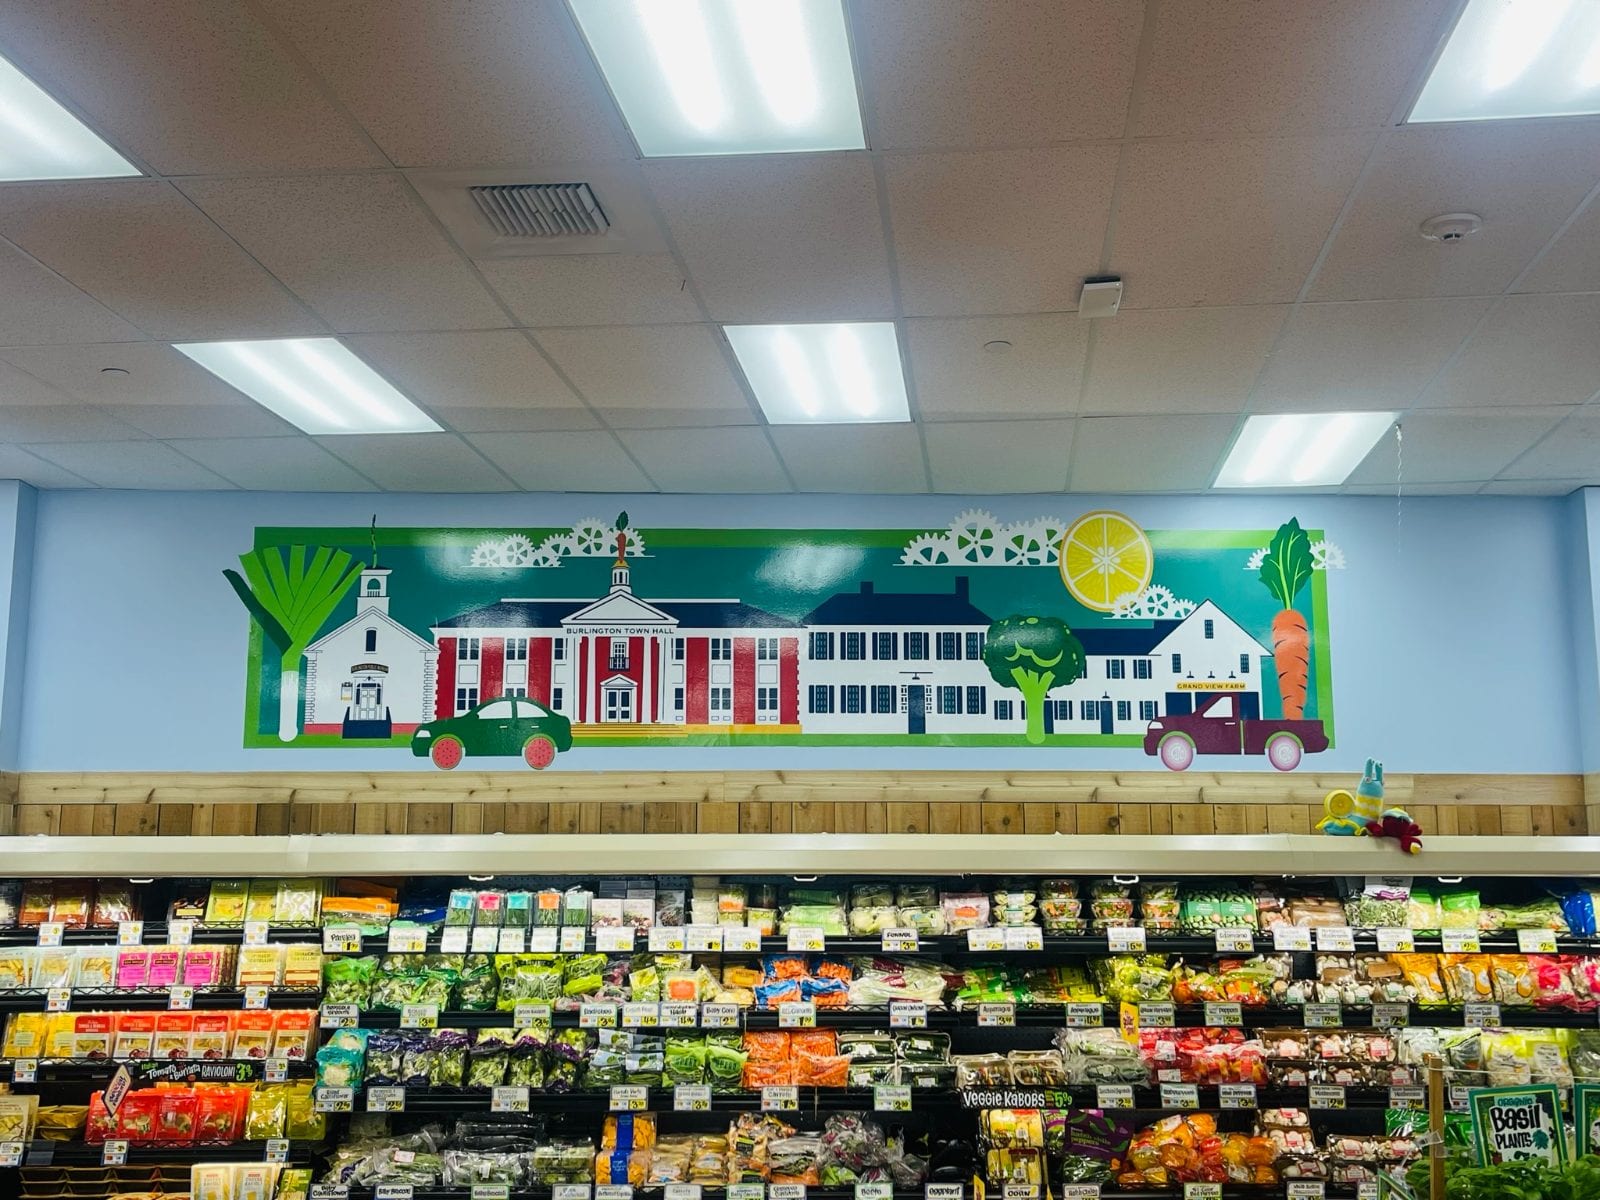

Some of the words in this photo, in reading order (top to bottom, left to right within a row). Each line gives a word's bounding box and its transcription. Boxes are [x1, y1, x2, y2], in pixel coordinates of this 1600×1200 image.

[146, 1064, 177, 1080] Tomato
[1490, 1104, 1541, 1133] Basil
[1494, 1131, 1534, 1150] PLANTS
